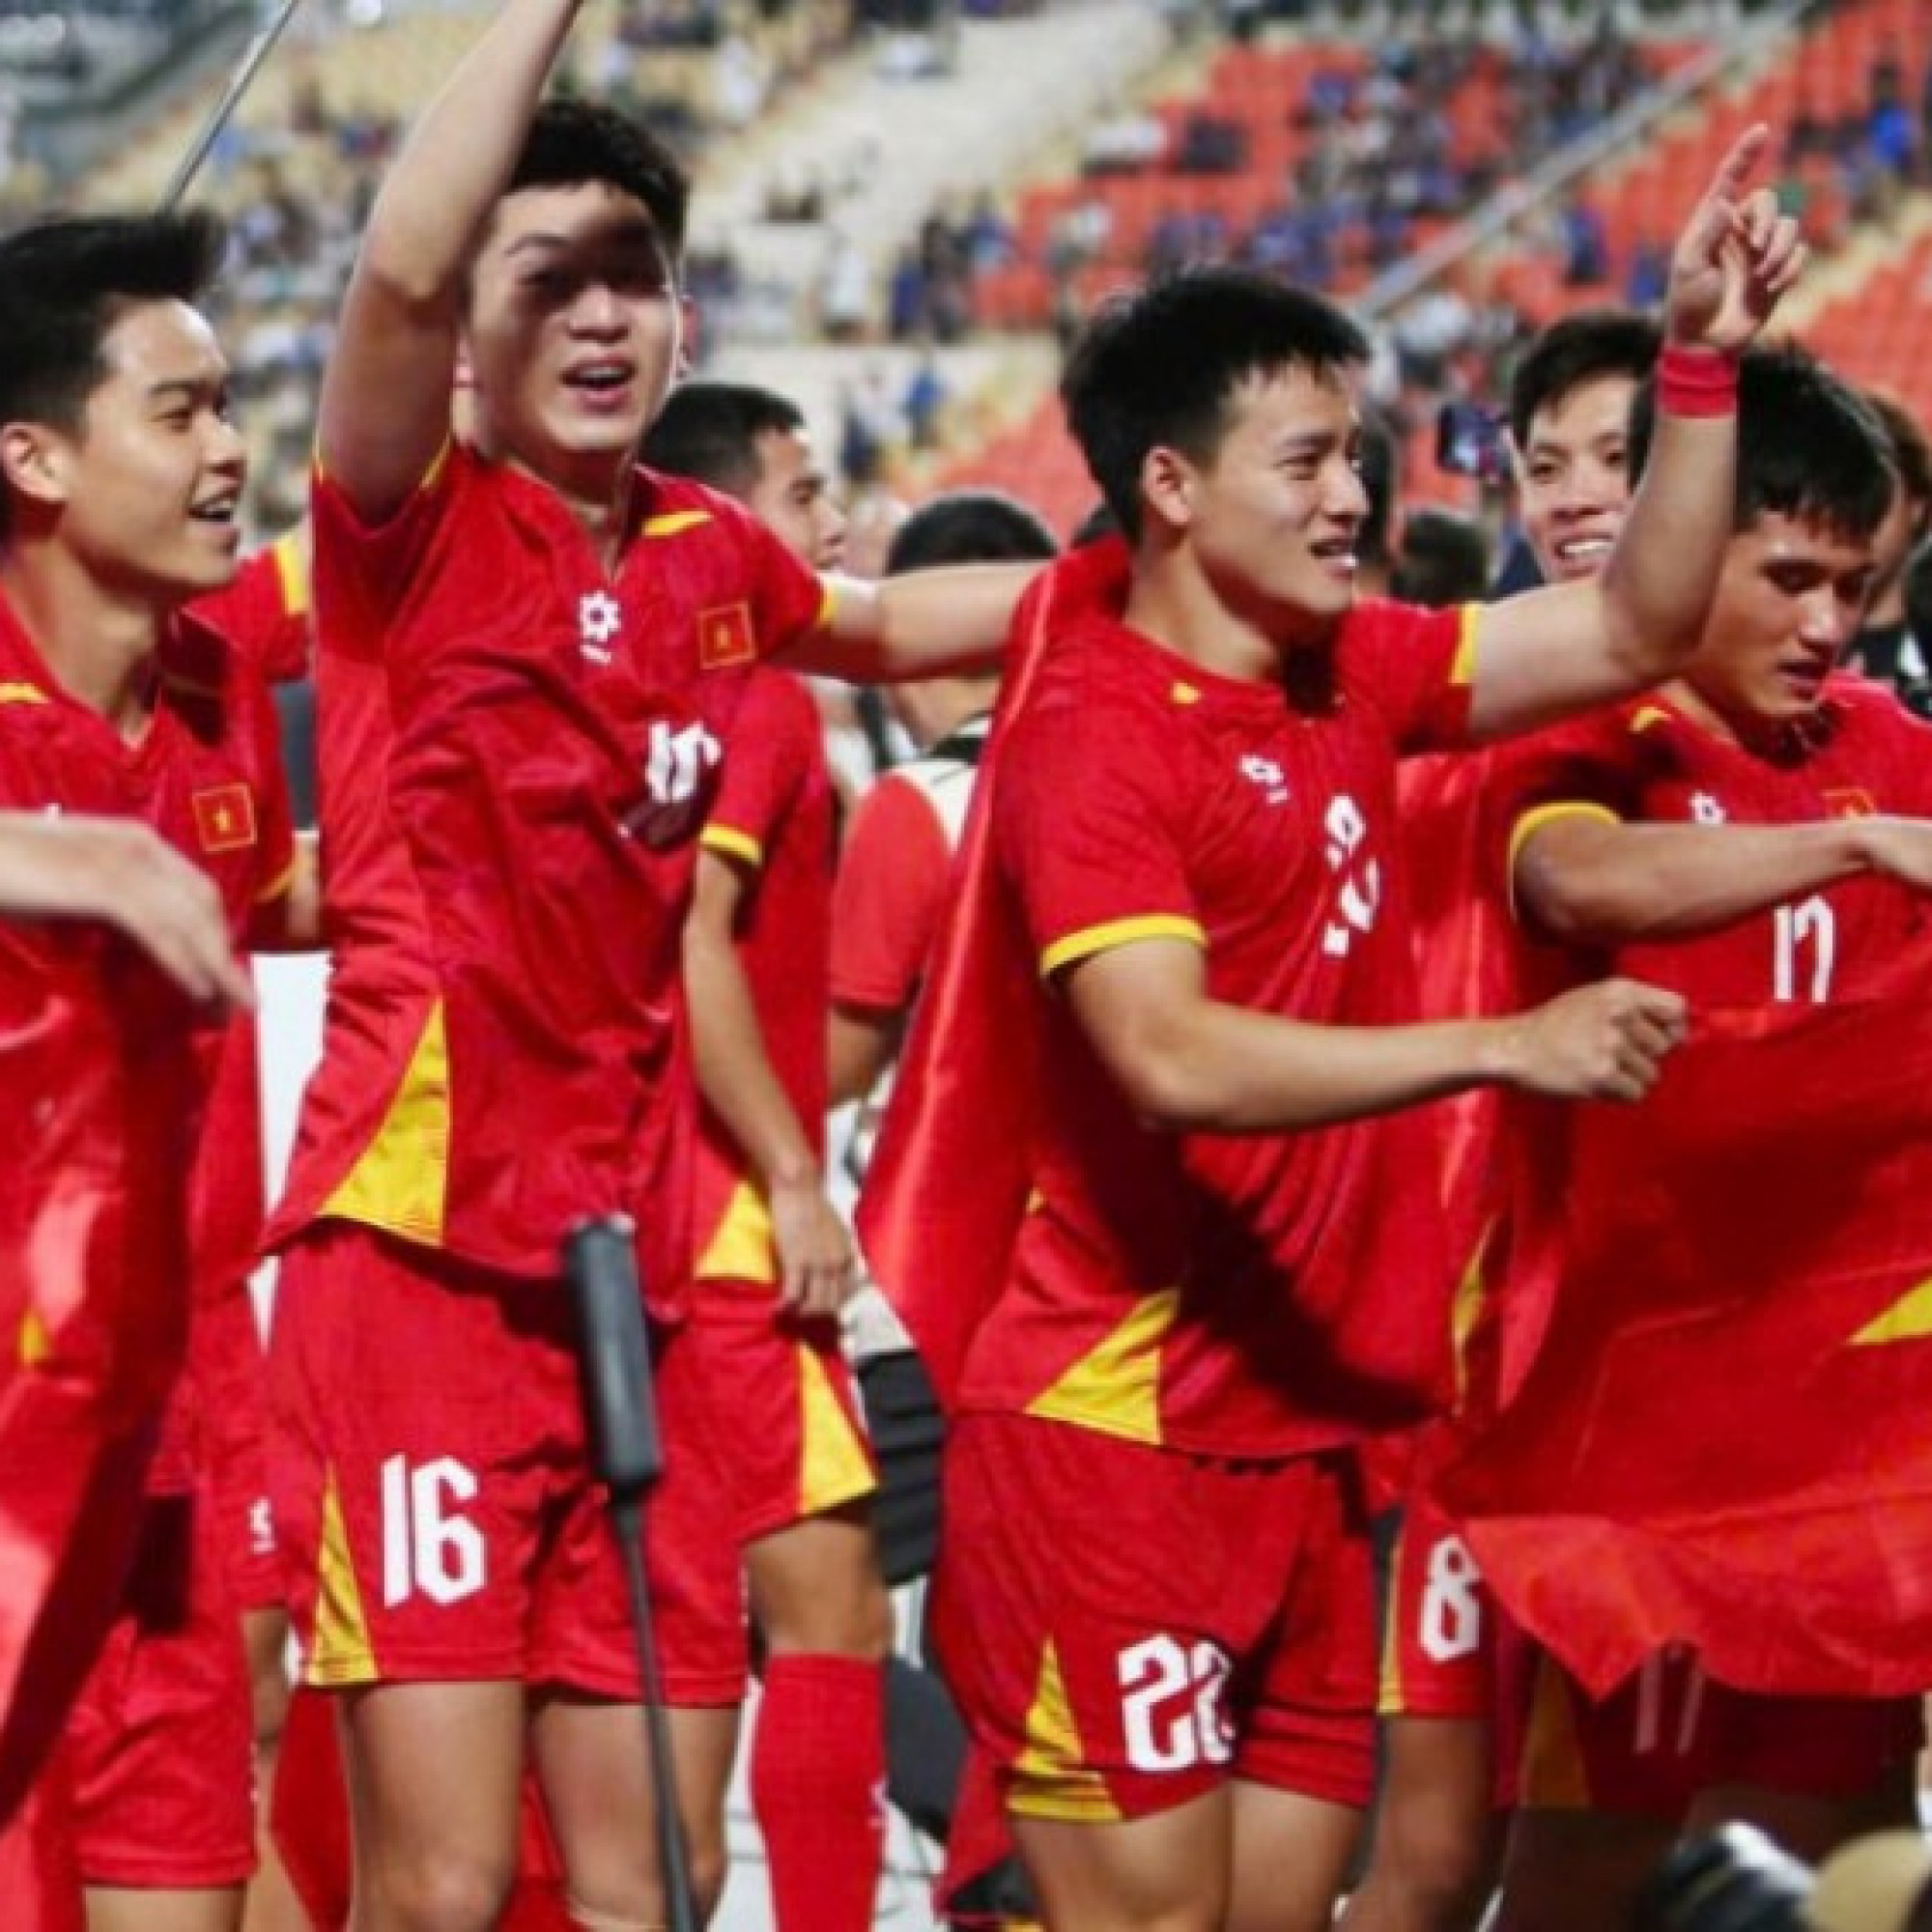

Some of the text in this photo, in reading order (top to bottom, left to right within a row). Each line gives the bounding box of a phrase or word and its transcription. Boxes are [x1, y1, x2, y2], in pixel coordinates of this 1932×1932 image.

[1773, 894, 1834, 1003] 17
[381, 1453, 487, 1608] 16
[1419, 1534, 1482, 1663] 8
